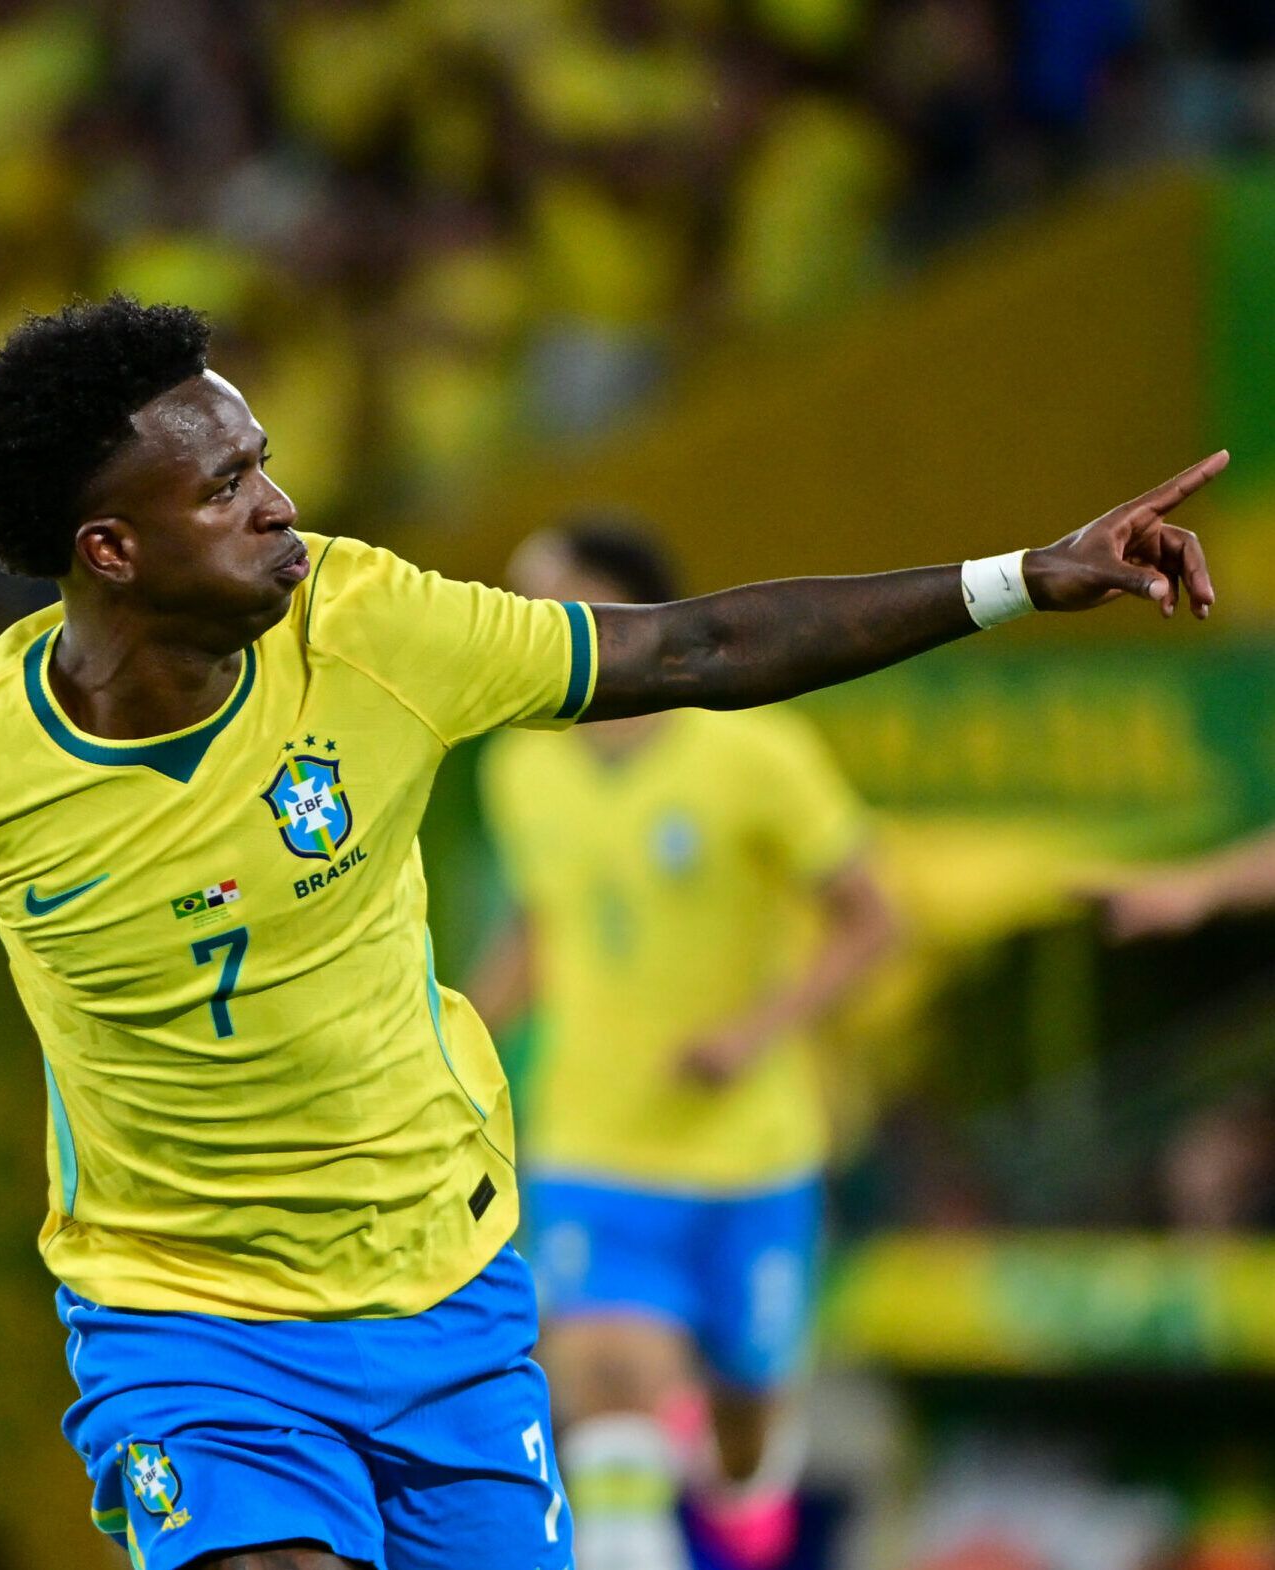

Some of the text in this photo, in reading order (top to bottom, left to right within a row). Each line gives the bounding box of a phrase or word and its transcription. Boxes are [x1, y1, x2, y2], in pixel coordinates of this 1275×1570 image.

[295, 793, 324, 817] CBF
[293, 846, 368, 899] BRASIL
[190, 926, 250, 1039] 7
[140, 1466, 158, 1486] CBF
[521, 1419, 562, 1543] 7
